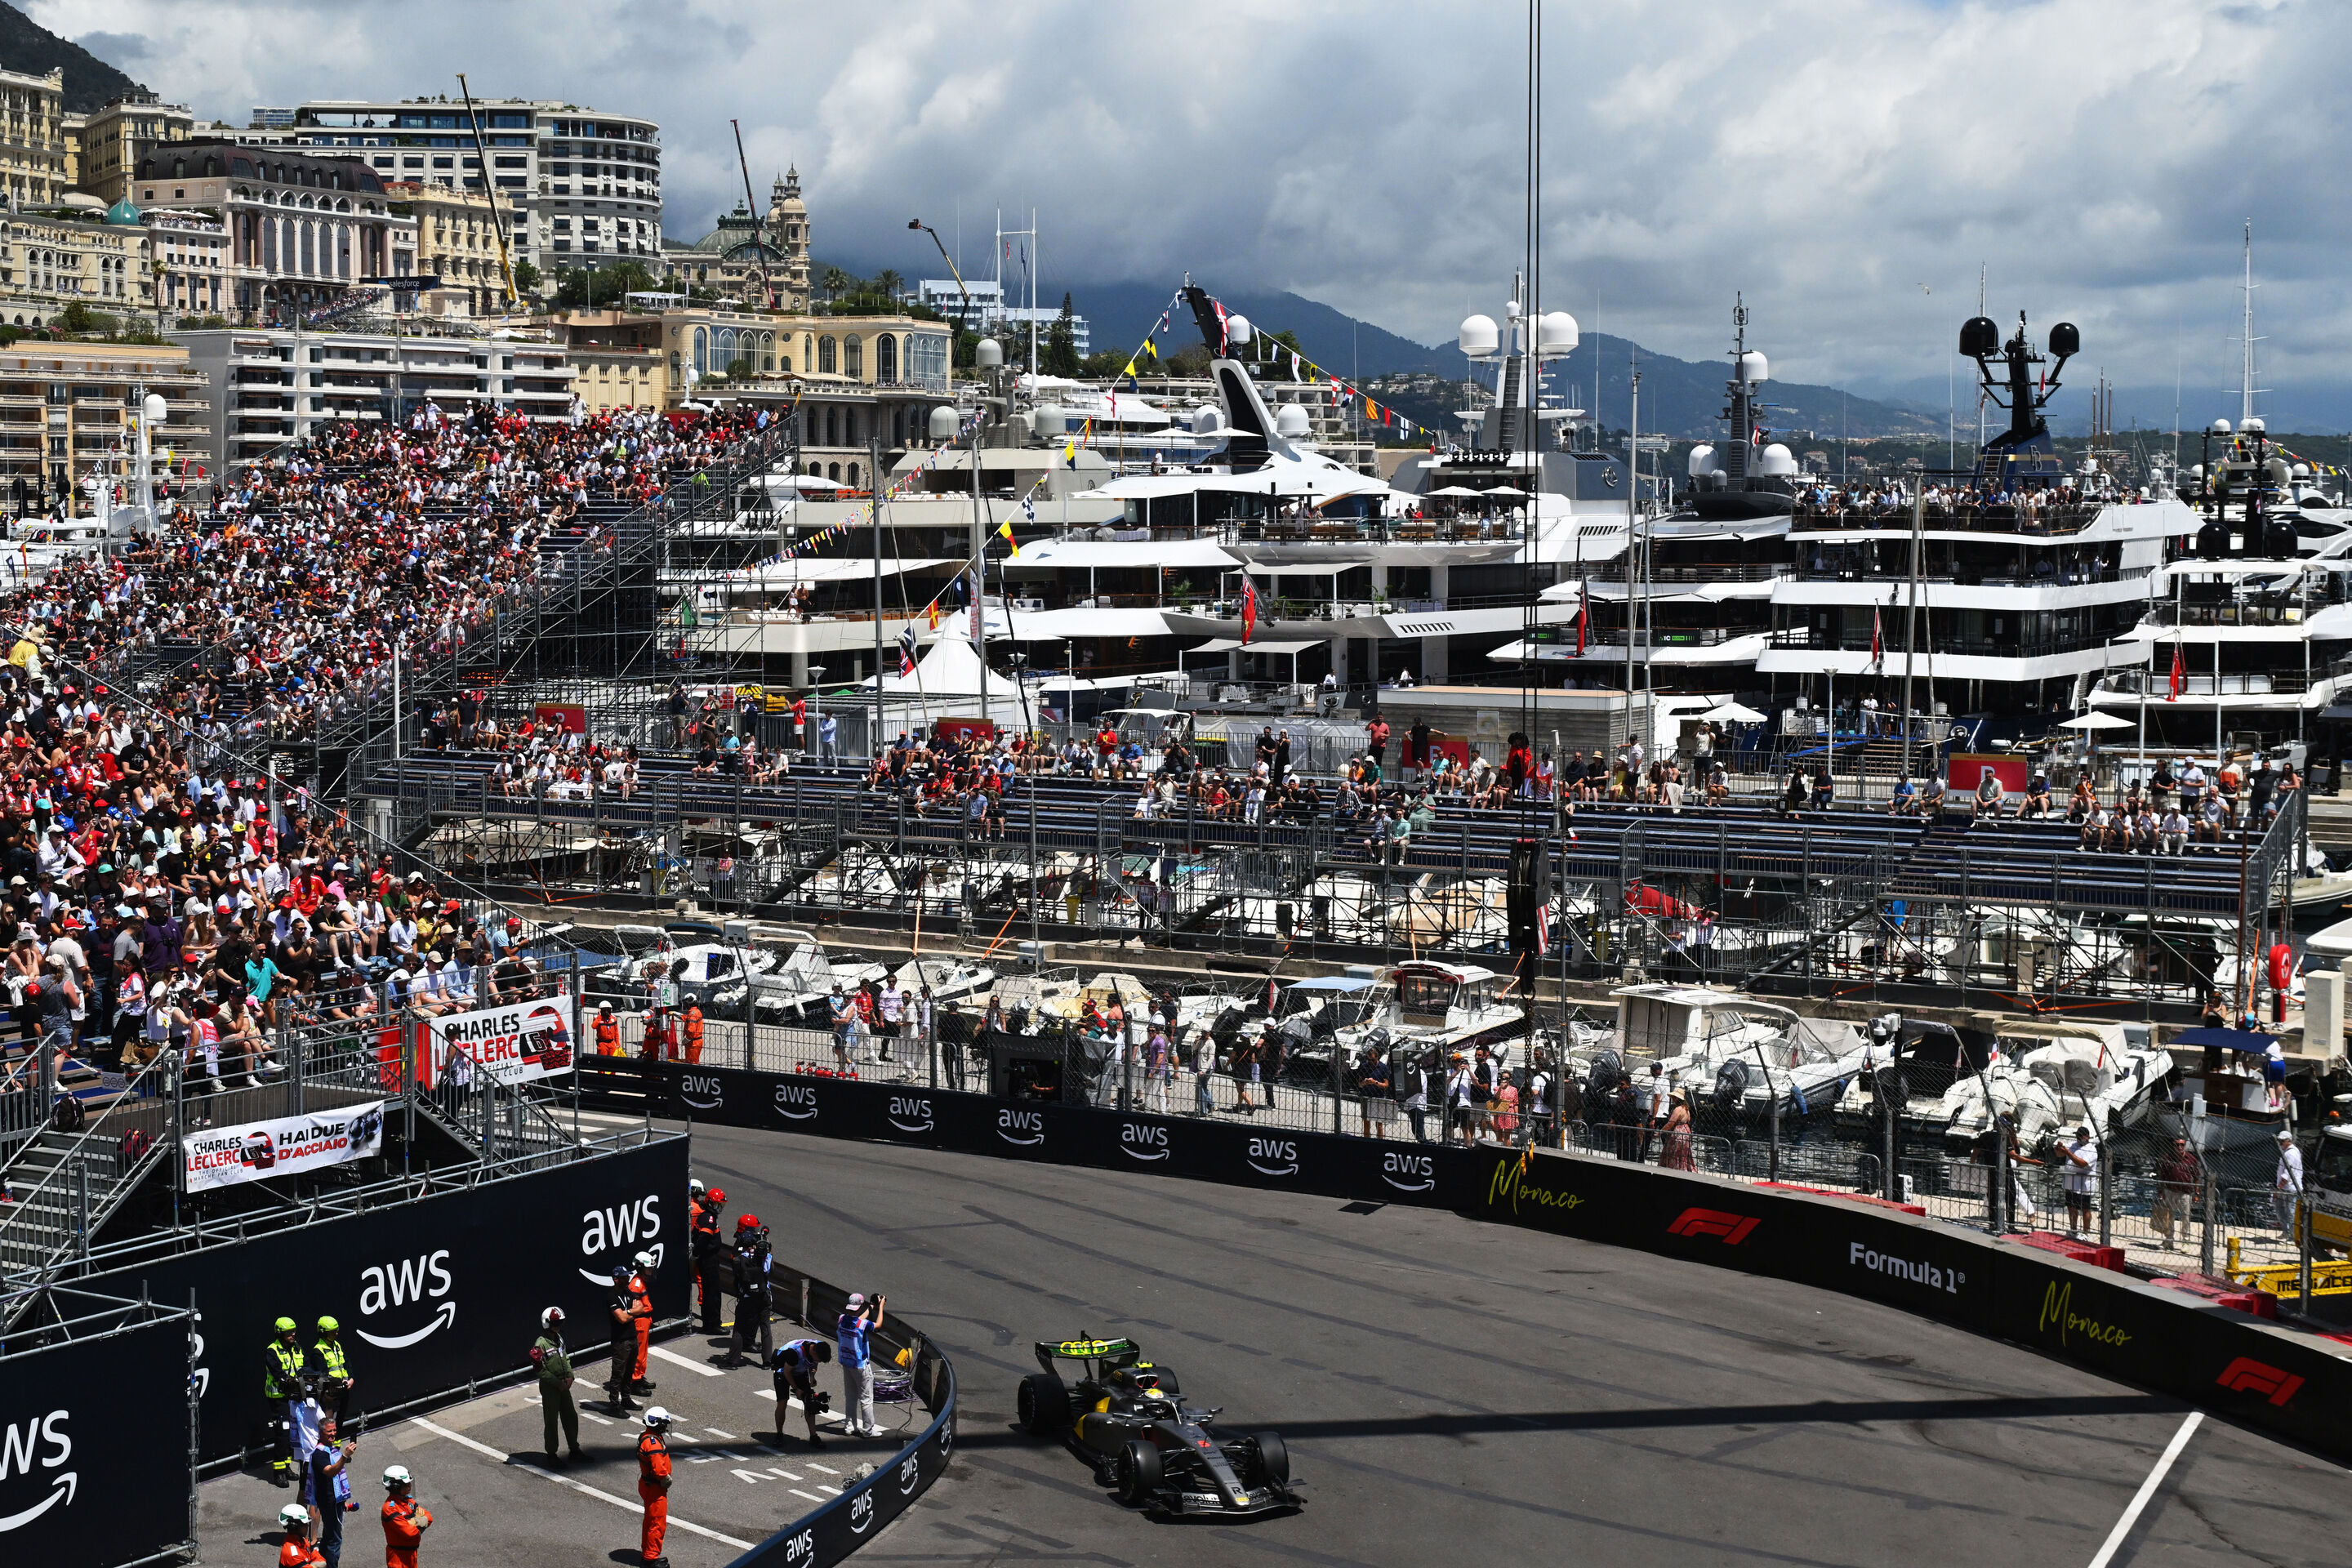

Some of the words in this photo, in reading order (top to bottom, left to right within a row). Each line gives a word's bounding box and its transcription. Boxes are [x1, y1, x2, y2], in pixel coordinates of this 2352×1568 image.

[389, 279, 420, 289] salesforce
[446, 1013, 520, 1041] HARLES
[434, 1034, 519, 1071] LLERC
[503, 1067, 523, 1077] CLUB
[683, 1076, 720, 1094] aws
[775, 1085, 816, 1105] aws
[890, 1097, 931, 1117] aws
[999, 1110, 1042, 1130] aws
[279, 1129, 309, 1146] HAI
[311, 1122, 345, 1139] DUE
[1122, 1124, 1168, 1145] aws
[194, 1136, 242, 1156] CHARLES
[278, 1137, 348, 1160] D'ACCIAIO
[1250, 1138, 1296, 1160] aws
[188, 1149, 240, 1172] LECLERC
[212, 1165, 236, 1174] OFFICIAL
[1384, 1153, 1432, 1176] aws
[194, 1174, 215, 1182] MARCHE
[1488, 1159, 1585, 1216] Monaco
[582, 1196, 661, 1254] aws
[1850, 1241, 1942, 1290] Formula
[360, 1250, 452, 1315] aws
[2039, 1280, 2133, 1347] Monaco
[941, 1415, 951, 1444] aws
[902, 1451, 918, 1482] aws
[1230, 1486, 1243, 1494] R
[851, 1488, 872, 1520] aws
[787, 1528, 813, 1562] aws
